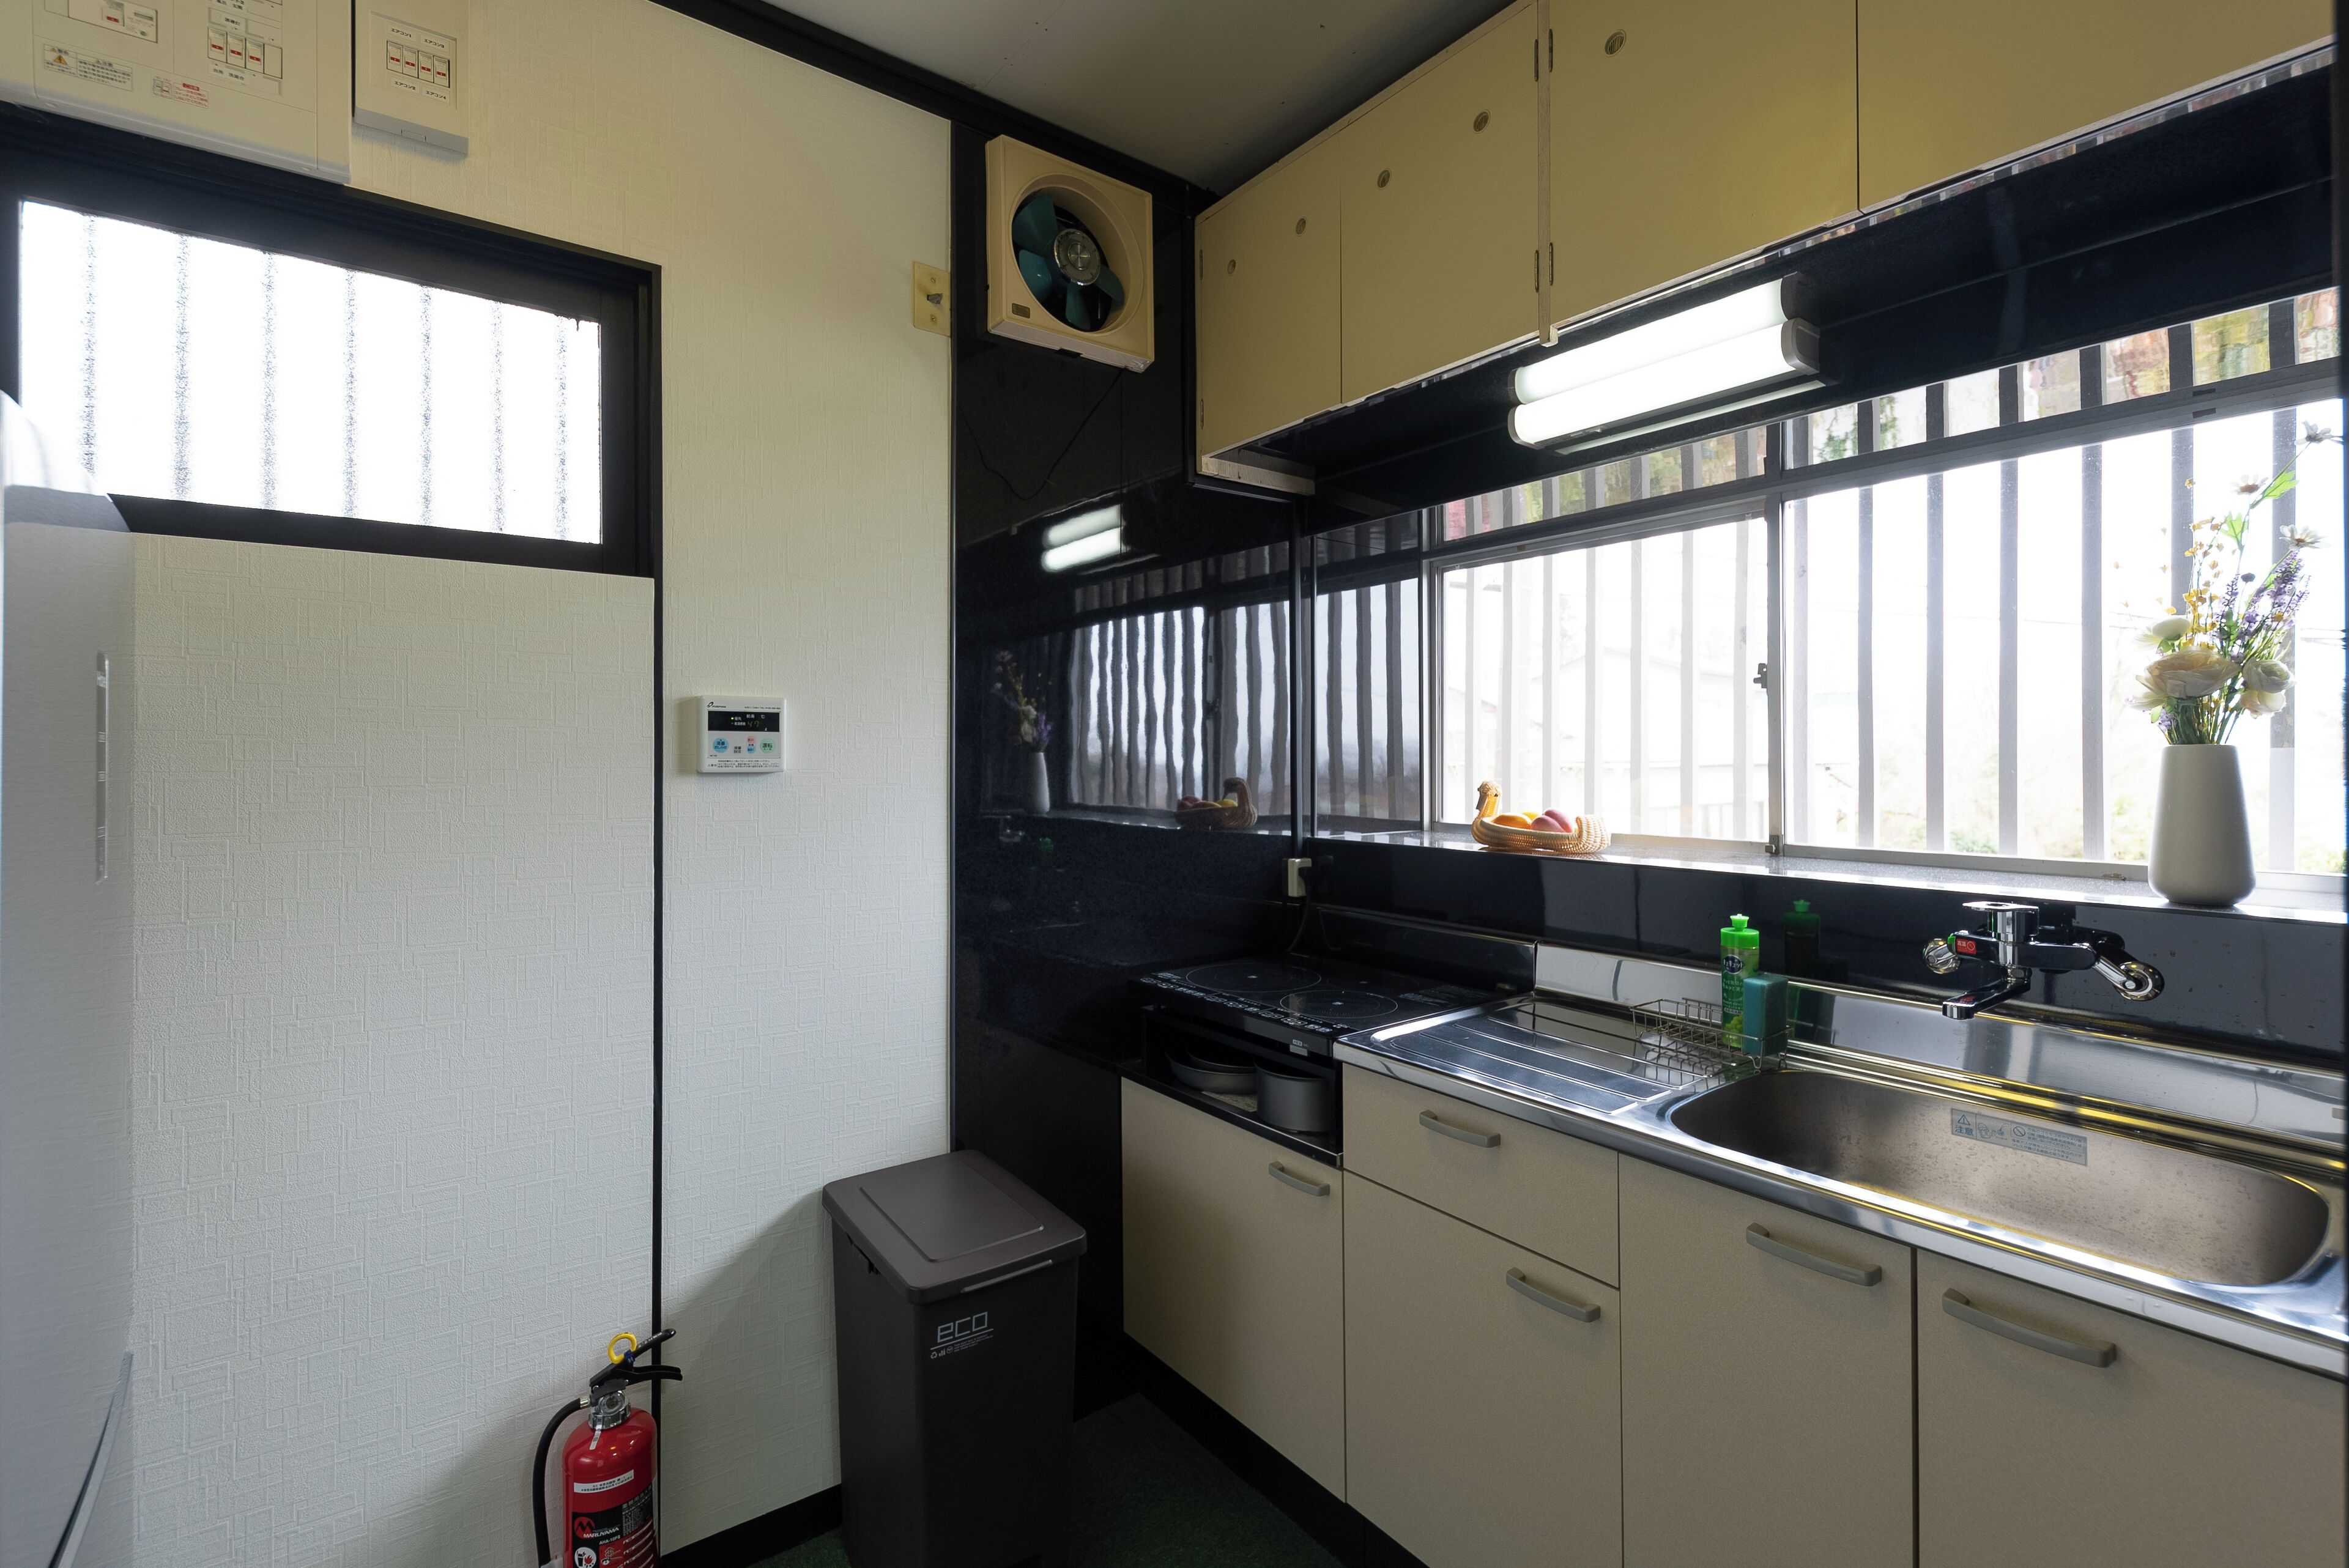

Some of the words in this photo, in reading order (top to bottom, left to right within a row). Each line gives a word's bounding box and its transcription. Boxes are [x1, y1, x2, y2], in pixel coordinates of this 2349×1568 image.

[391, 28, 412, 37] エアコン1
[425, 91, 447, 100] エアコン4
[1723, 959, 1743, 969] キュキュット
[1955, 1125, 1974, 1136] 注意
[937, 1312, 988, 1343] eco
[583, 1527, 620, 1539] MARUYAMA
